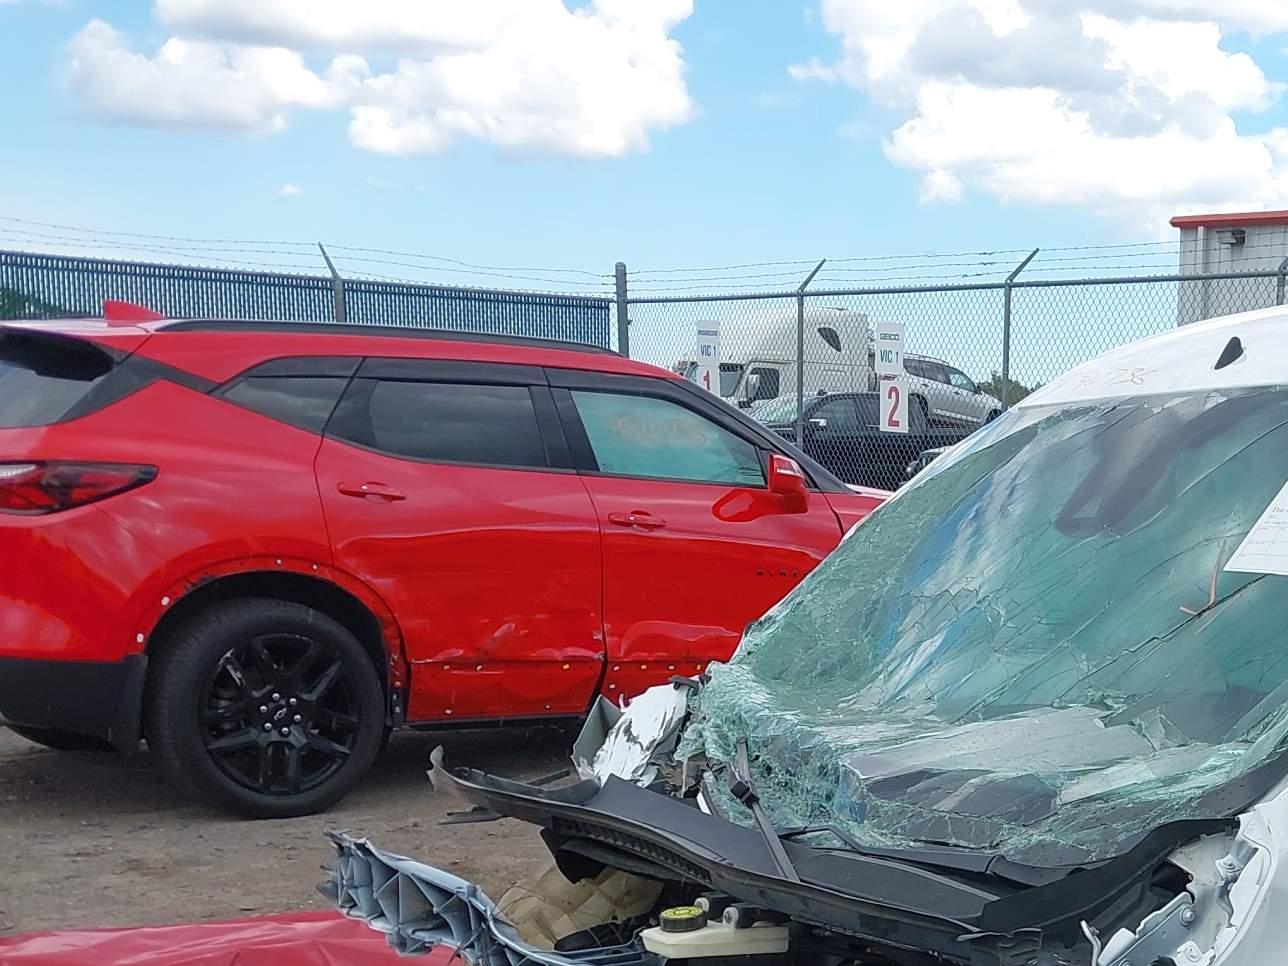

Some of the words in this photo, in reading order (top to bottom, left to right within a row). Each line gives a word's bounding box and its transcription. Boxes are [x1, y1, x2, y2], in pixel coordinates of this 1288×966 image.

[879, 333, 900, 341] GEICO
[700, 343, 711, 357] VIC
[880, 349, 893, 364] VIC
[887, 386, 900, 428] 2
